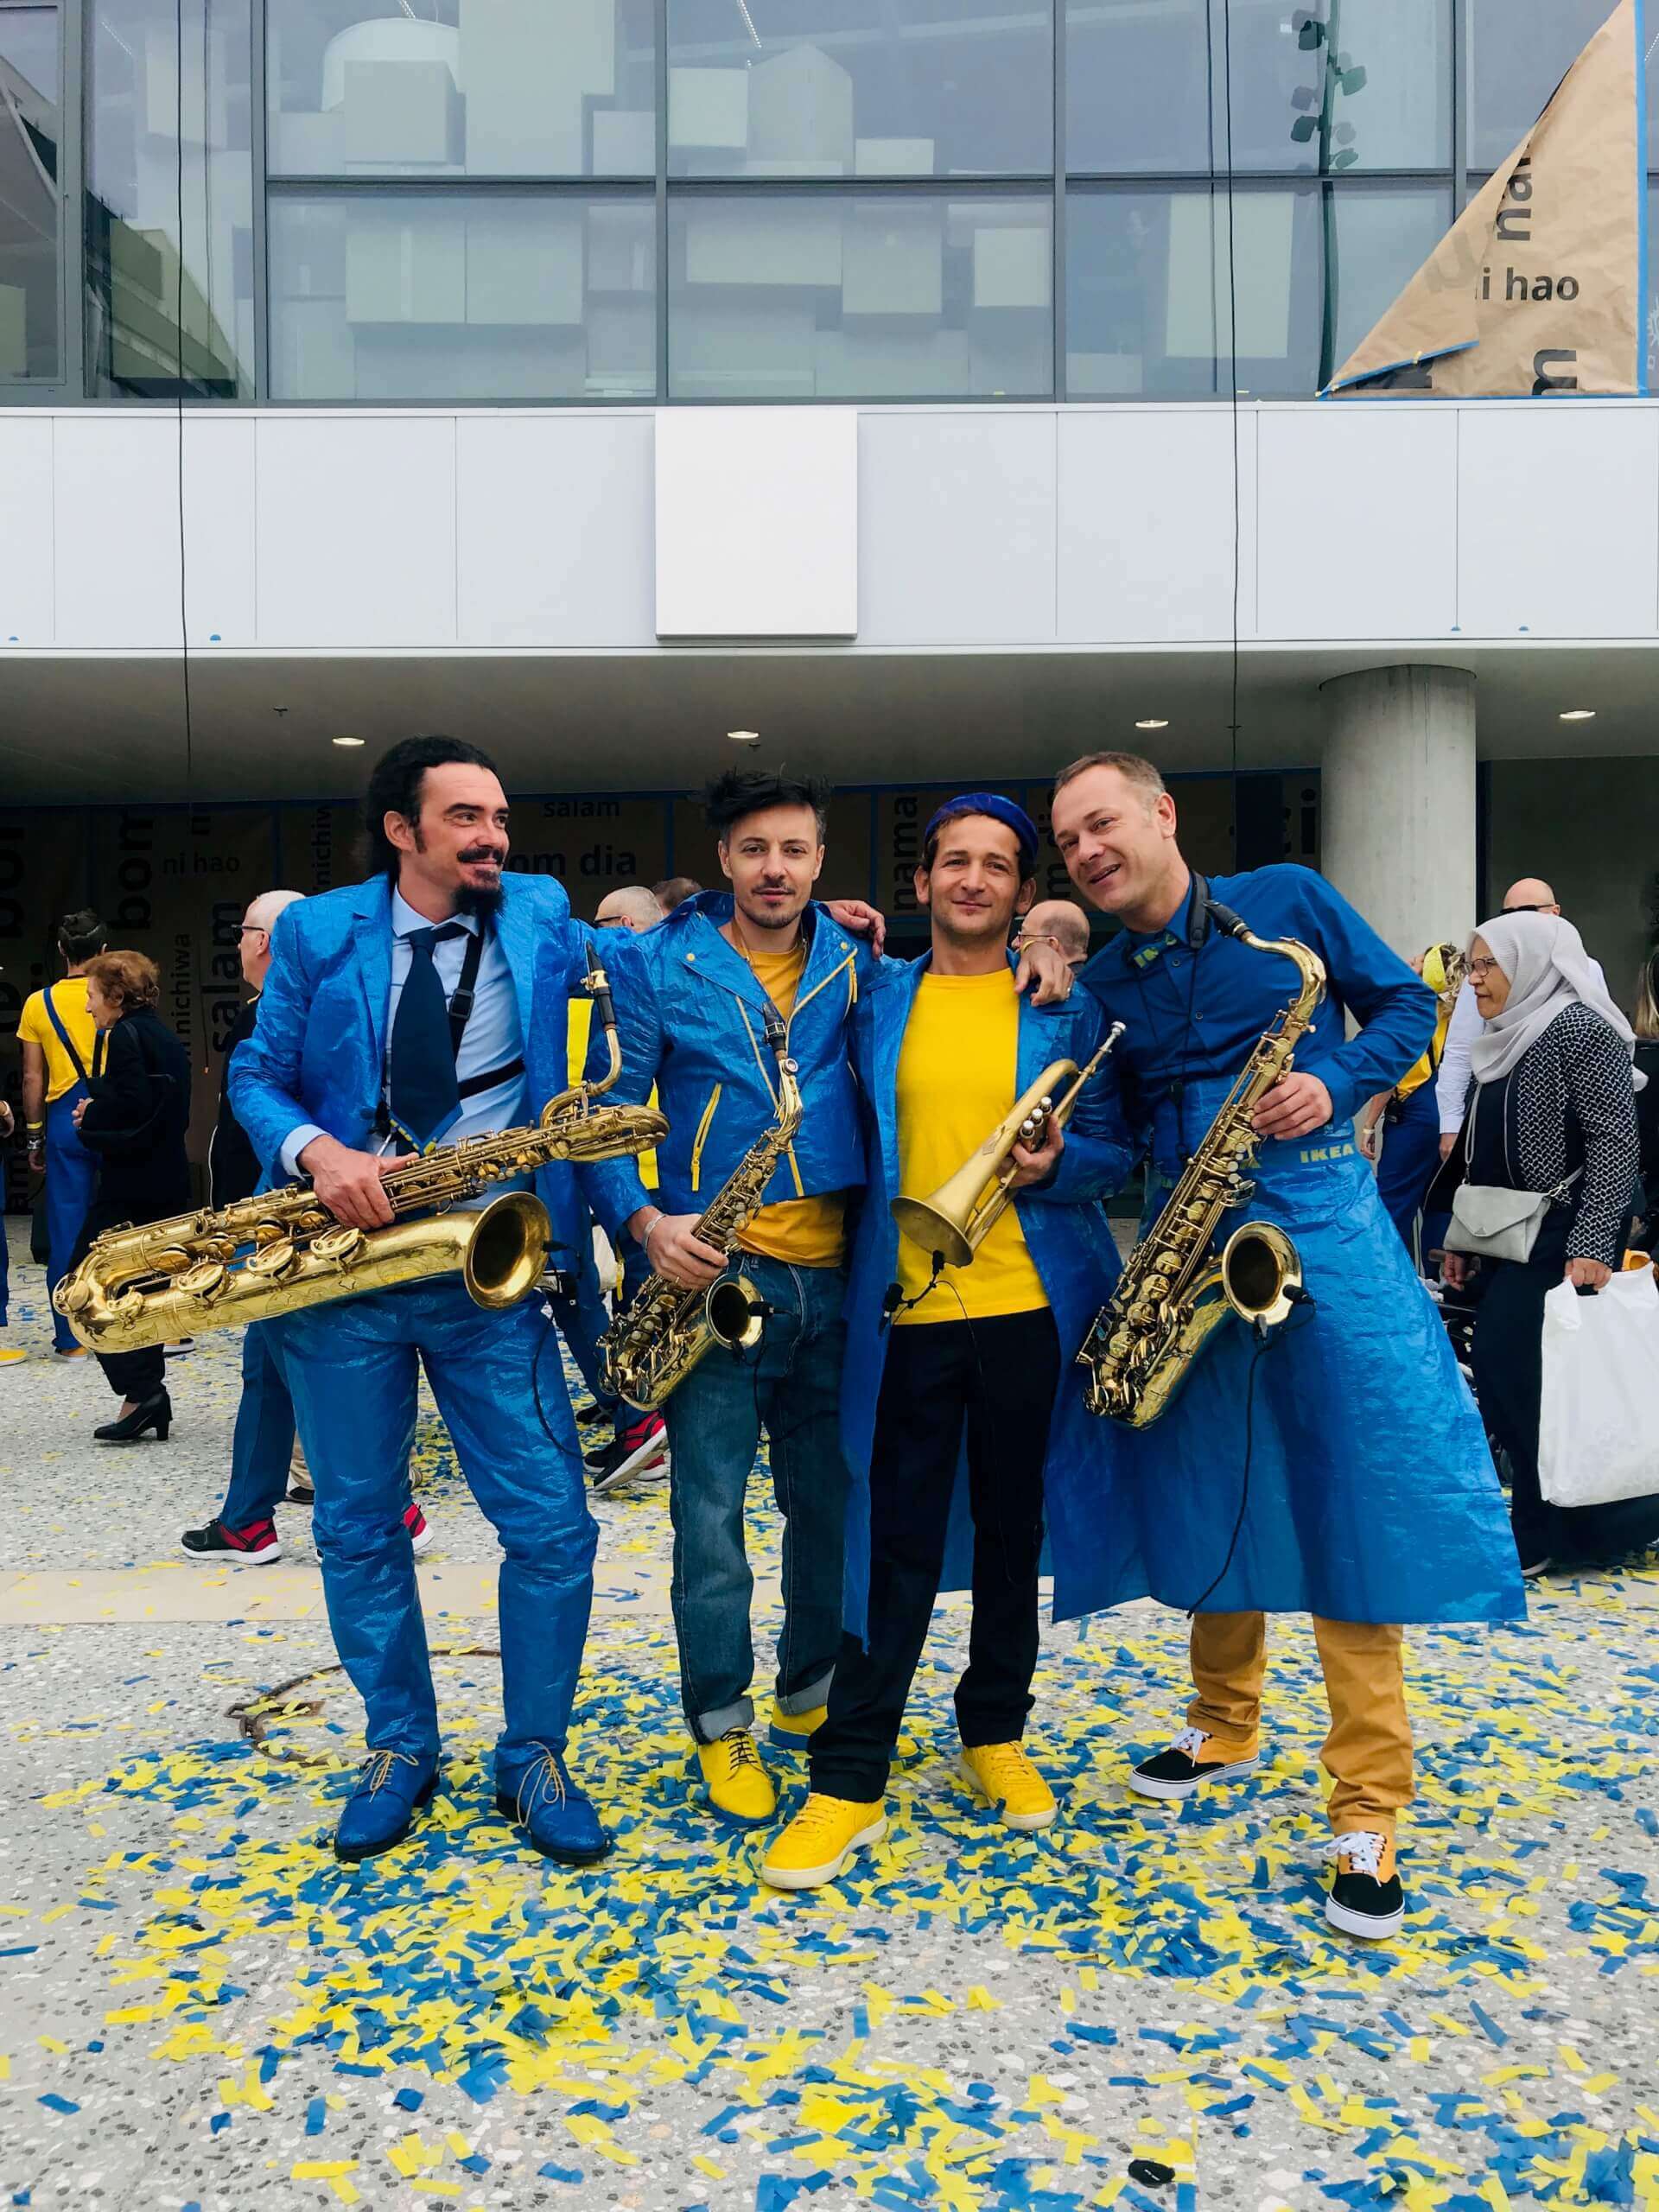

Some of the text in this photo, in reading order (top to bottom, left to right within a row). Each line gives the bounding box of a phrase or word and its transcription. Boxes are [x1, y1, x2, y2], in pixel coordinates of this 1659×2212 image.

[1505, 267, 1580, 301] hao
[543, 799, 620, 817] salam
[163, 850, 240, 874] ni hao
[508, 844, 637, 876] om dia
[201, 902, 243, 1052] salam
[1300, 1143, 1355, 1164] IKEA
